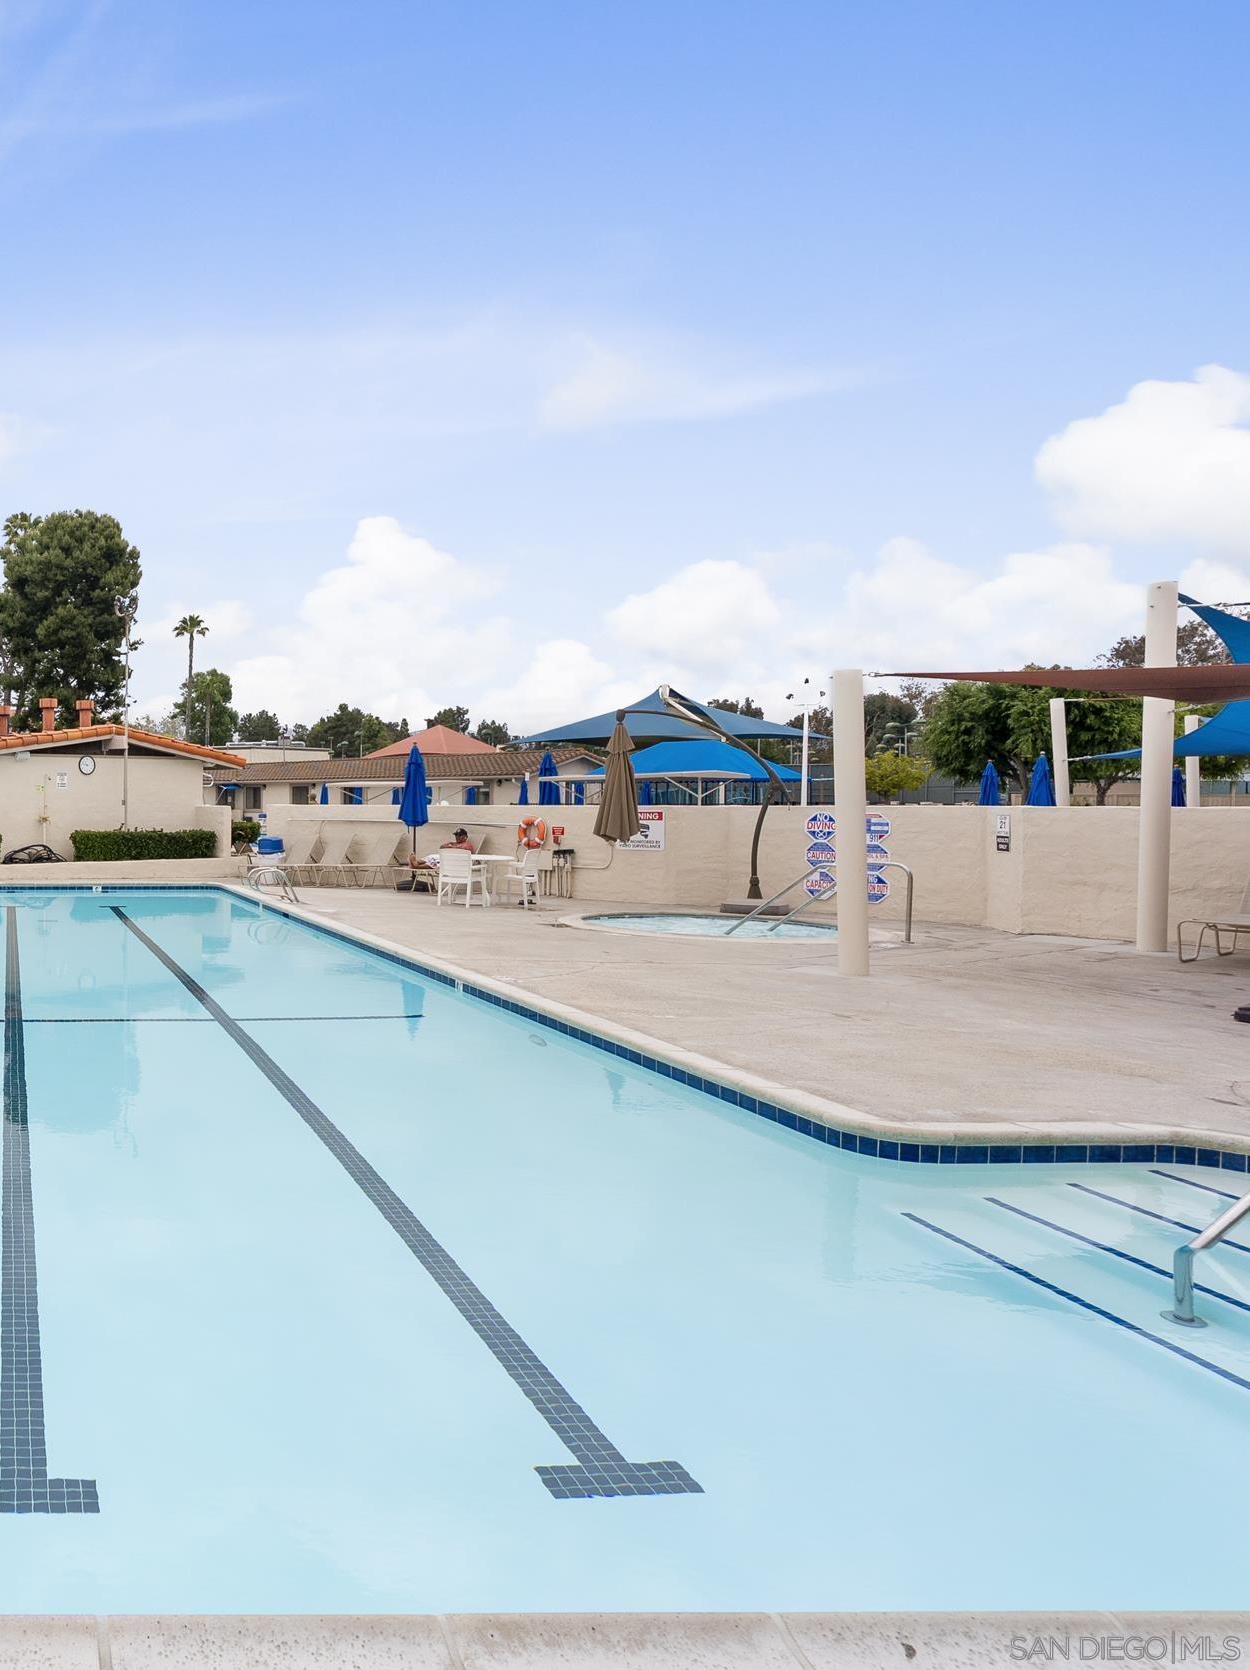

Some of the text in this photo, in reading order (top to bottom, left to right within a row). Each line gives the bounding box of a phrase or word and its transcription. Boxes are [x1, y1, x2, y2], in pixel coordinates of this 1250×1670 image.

[638, 812, 659, 820] NING
[817, 813, 829, 821] NO
[870, 834, 879, 842] 911
[806, 851, 836, 860] CAUTION
[806, 880, 833, 889] CAPACI
